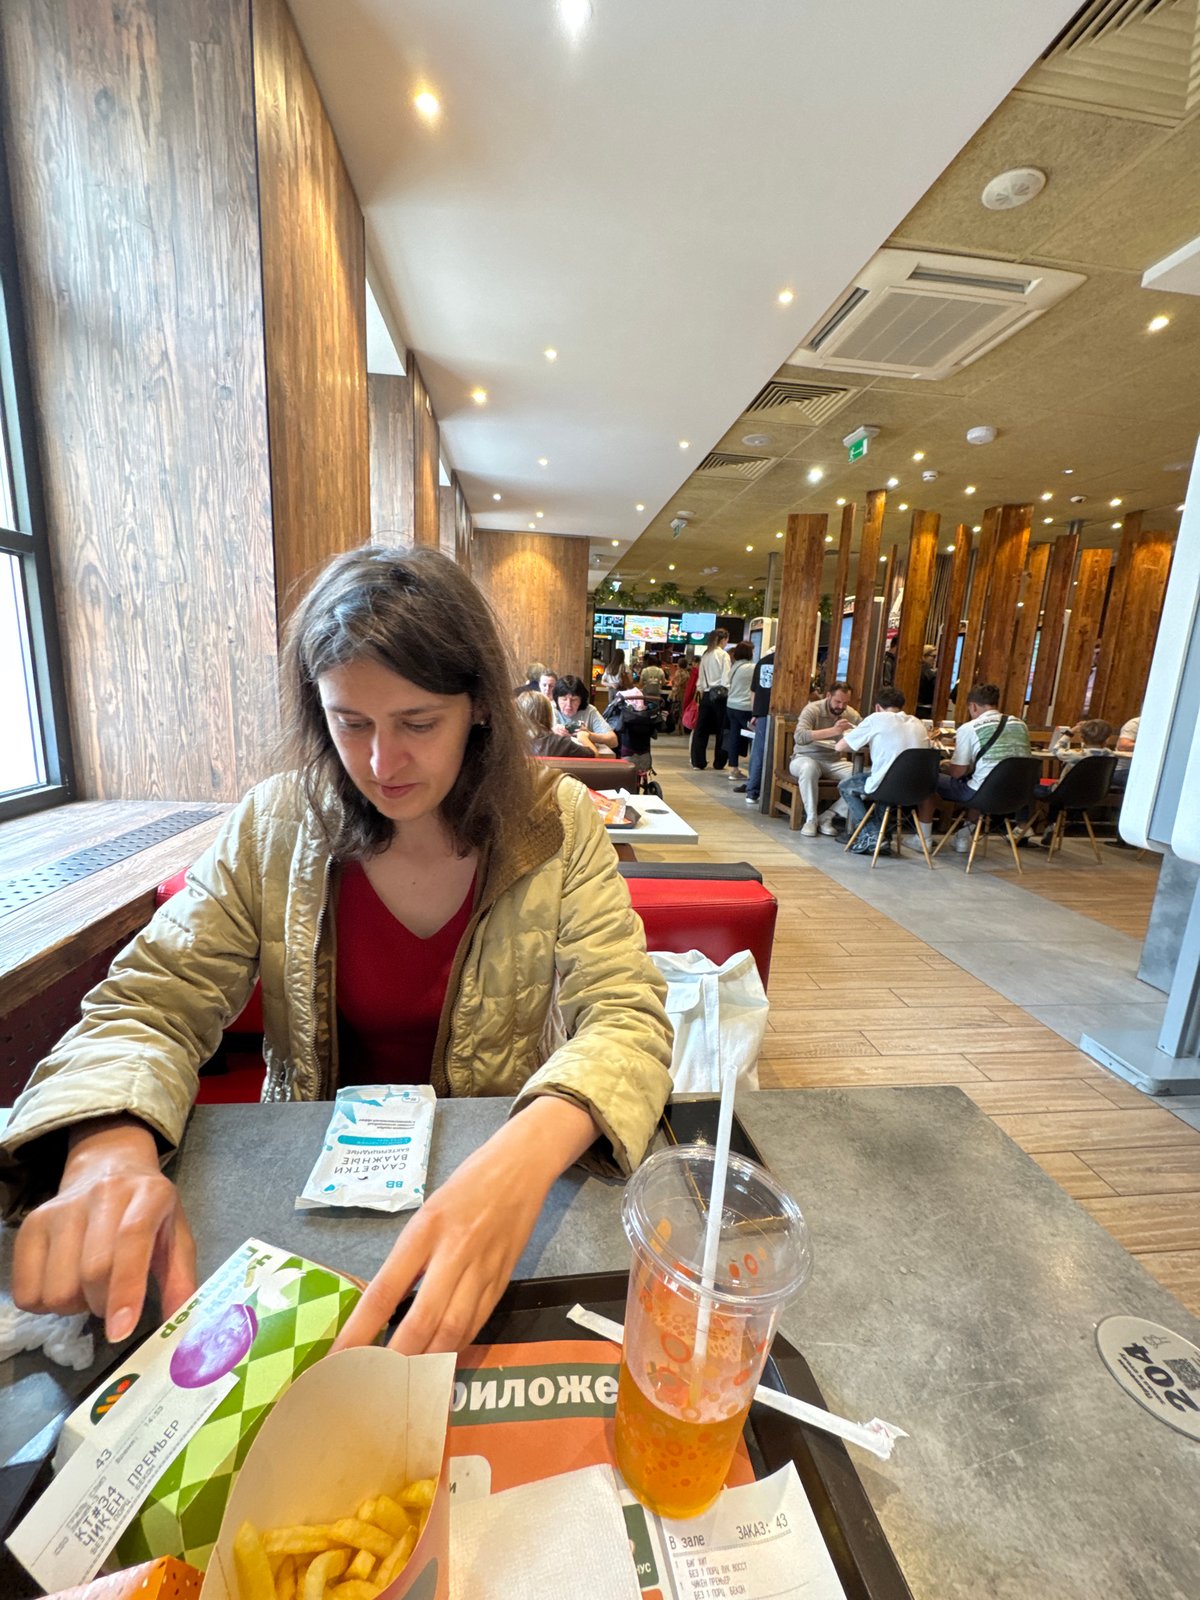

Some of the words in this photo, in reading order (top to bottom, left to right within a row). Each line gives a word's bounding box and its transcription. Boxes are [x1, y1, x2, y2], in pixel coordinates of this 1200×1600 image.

[334, 1162, 406, 1174] САЛФЕТКИ
[341, 1154, 408, 1165] ВЛАЖНЫЕ
[1122, 1342, 1200, 1412] 204
[96, 1448, 112, 1469] 43
[82, 1491, 125, 1547] ЧИКЕН
[127, 1419, 179, 1487] ПРЕМЬЕР
[74, 1485, 117, 1542] КТ#34
[668, 1536, 677, 1550] В
[681, 1534, 705, 1548] зале
[736, 1521, 771, 1540] ЗАКАЗ:
[776, 1513, 788, 1529] 43
